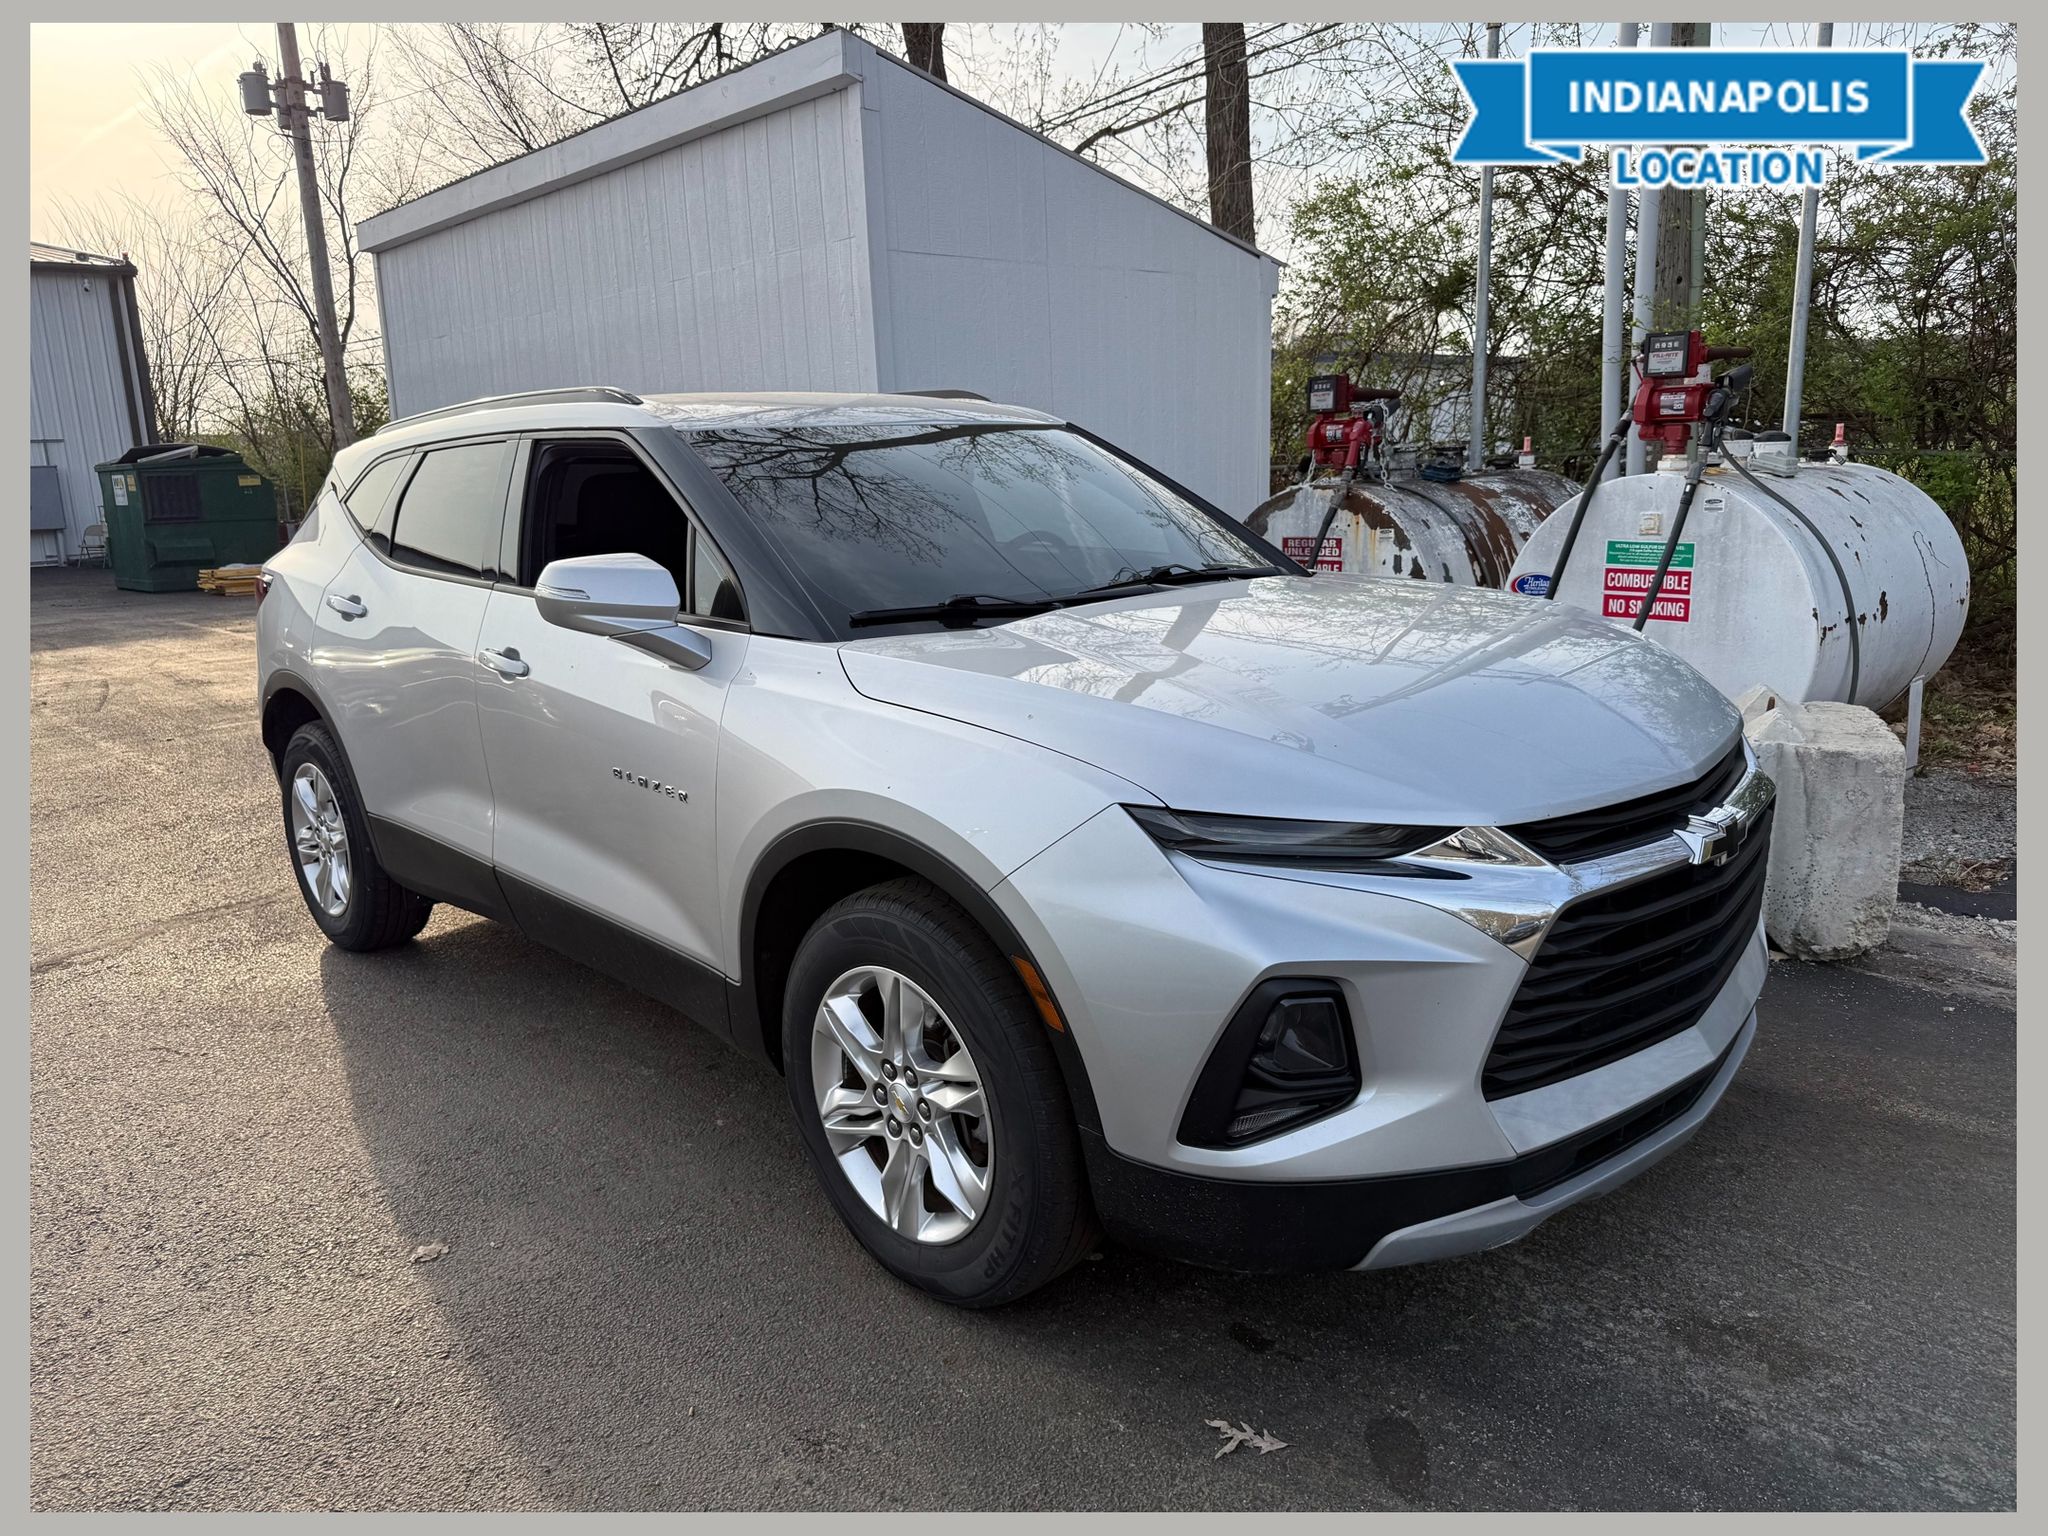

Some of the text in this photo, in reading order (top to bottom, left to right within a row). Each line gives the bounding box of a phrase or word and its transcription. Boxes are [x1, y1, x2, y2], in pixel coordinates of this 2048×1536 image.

[1284, 547, 1340, 556] UNLEDED
[1287, 539, 1337, 548] REGUAR
[1607, 572, 1689, 591] COMBUSIBLE
[1608, 598, 1625, 614] NO
[611, 766, 689, 804] BLAZER
